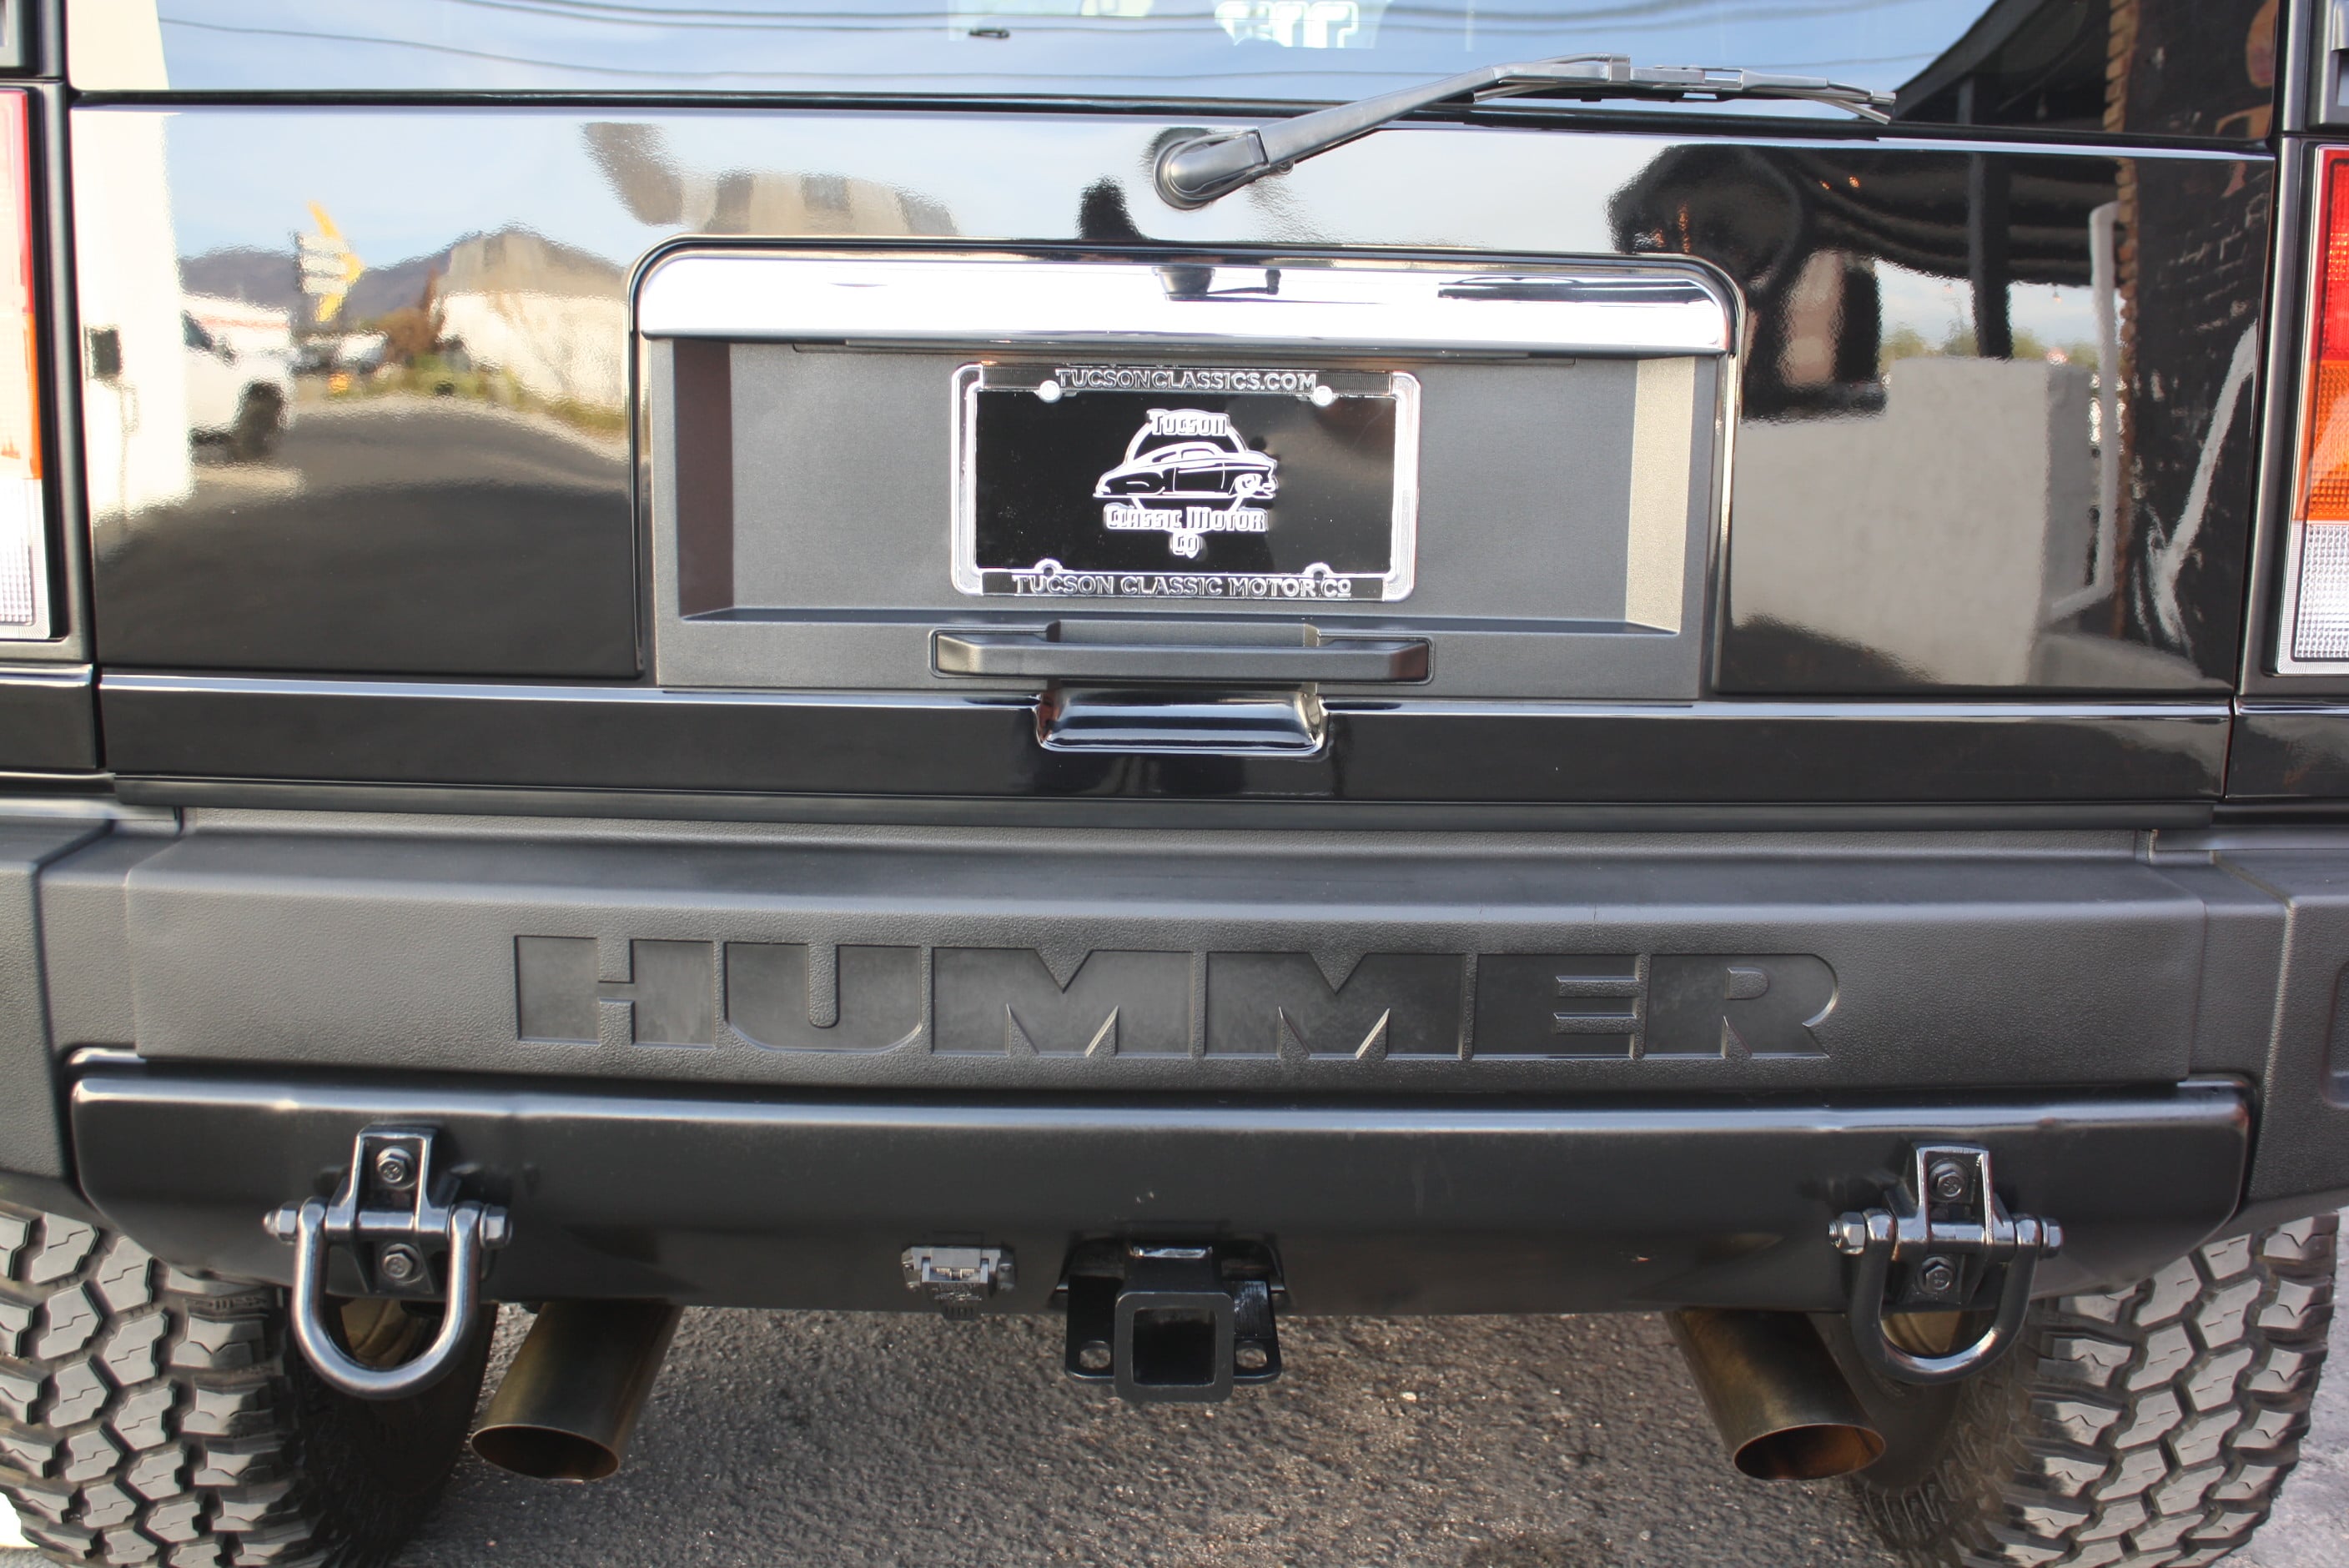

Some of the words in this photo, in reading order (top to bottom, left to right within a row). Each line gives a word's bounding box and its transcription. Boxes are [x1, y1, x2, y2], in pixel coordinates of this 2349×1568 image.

[1055, 369, 1315, 390] TUCSONCLASSICS.COM
[1012, 574, 1114, 595] TUCSON
[1120, 575, 1222, 596] CLASSIC
[1229, 577, 1317, 598] MOTOR
[513, 935, 1839, 1060] HUMMER
